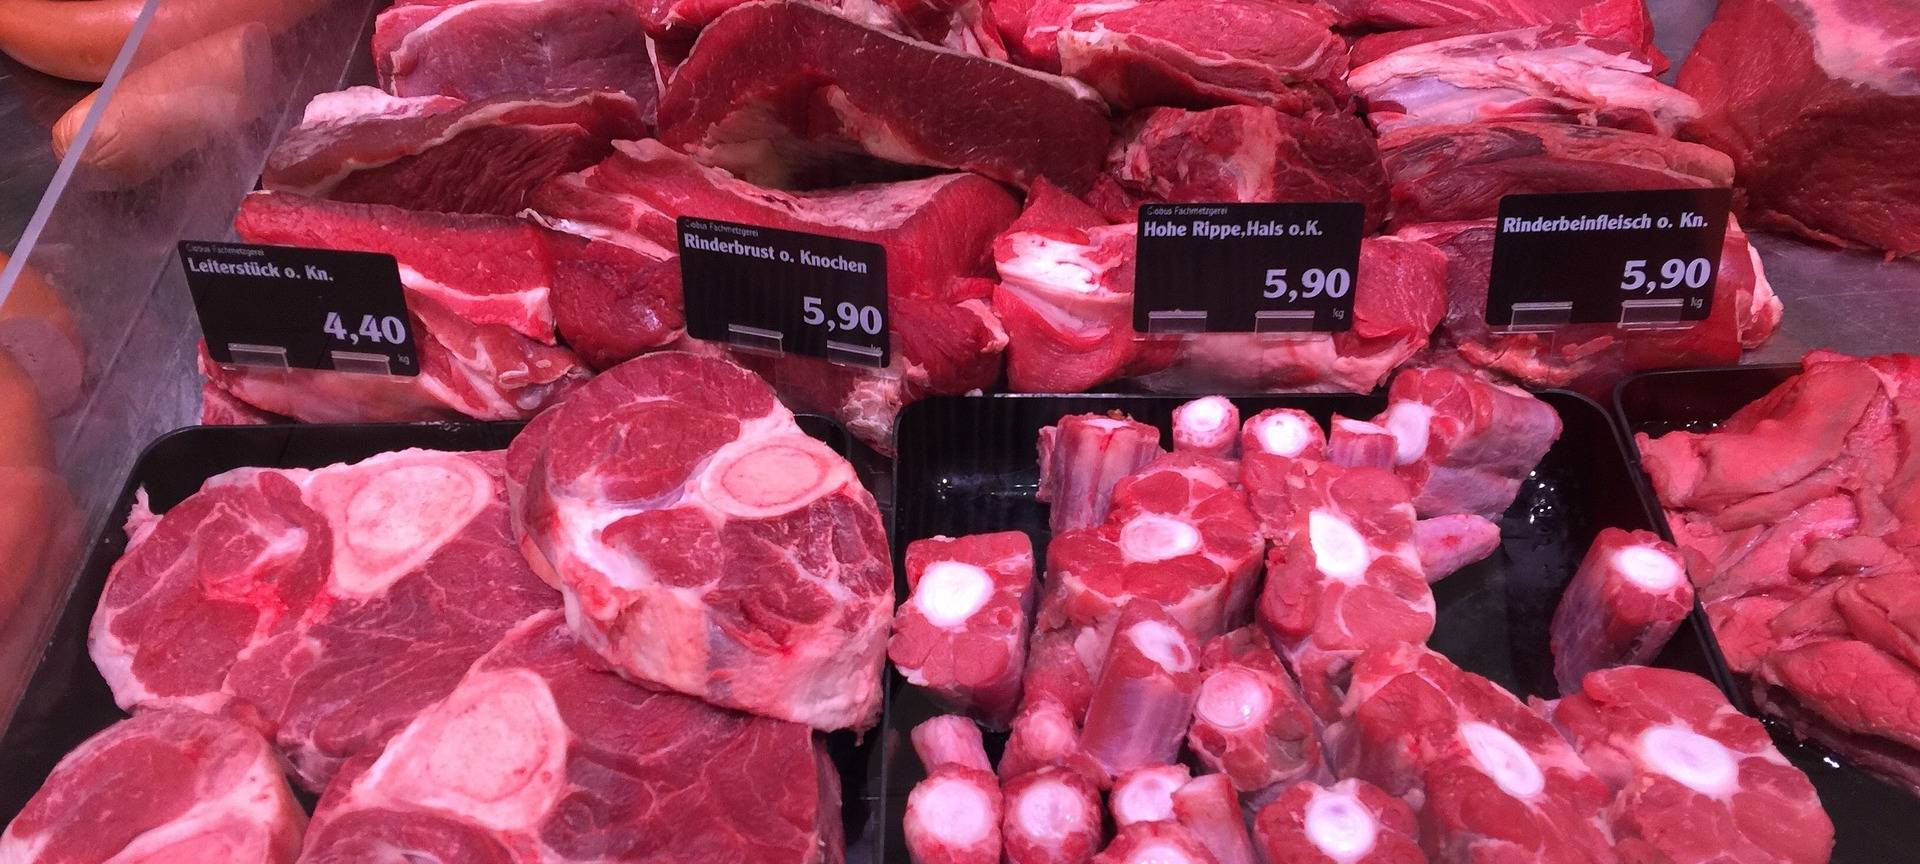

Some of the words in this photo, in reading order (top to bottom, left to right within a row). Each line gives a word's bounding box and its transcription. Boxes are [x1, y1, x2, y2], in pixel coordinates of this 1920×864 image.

[1174, 206, 1228, 217] Fachmetzgerei
[1503, 213, 1651, 233] Rinderbeinfleisch
[1657, 216, 1673, 229] o.
[1680, 212, 1708, 228] Kn.
[1144, 221, 1187, 237] Hohe
[1192, 220, 1284, 240] Rippe,Hals
[1288, 220, 1323, 237] o.K.
[684, 232, 775, 261] Rinderbrust
[780, 250, 795, 263] o.
[800, 250, 868, 274] Knochen
[187, 257, 281, 278] Leiterstück
[284, 266, 301, 279] o.
[305, 264, 334, 282] Kn.
[1620, 257, 1712, 295] 5,90
[1263, 268, 1350, 303] 5,90
[1332, 308, 1345, 320] kg
[1690, 296, 1704, 309] kg
[803, 296, 883, 335] 5,90
[323, 312, 406, 345] 4,40
